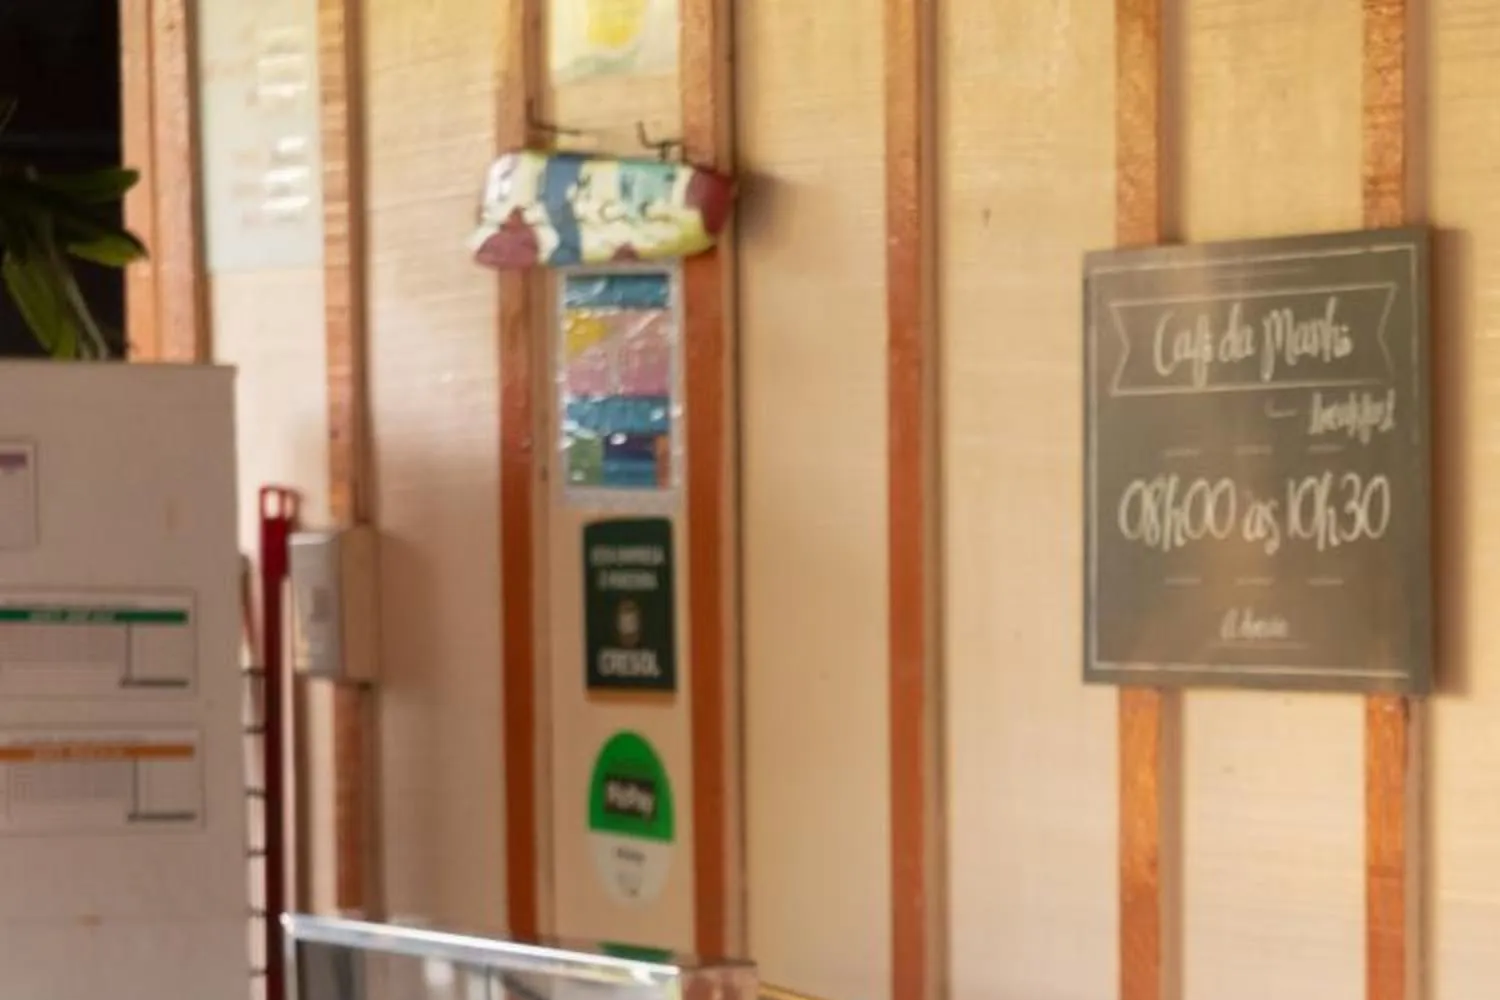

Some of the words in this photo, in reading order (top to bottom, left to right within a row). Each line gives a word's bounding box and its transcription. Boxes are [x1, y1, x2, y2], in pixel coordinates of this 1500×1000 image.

[1218, 302, 1256, 363] da
[1117, 473, 1237, 552] 08h00
[1288, 469, 1391, 552] 10h30
